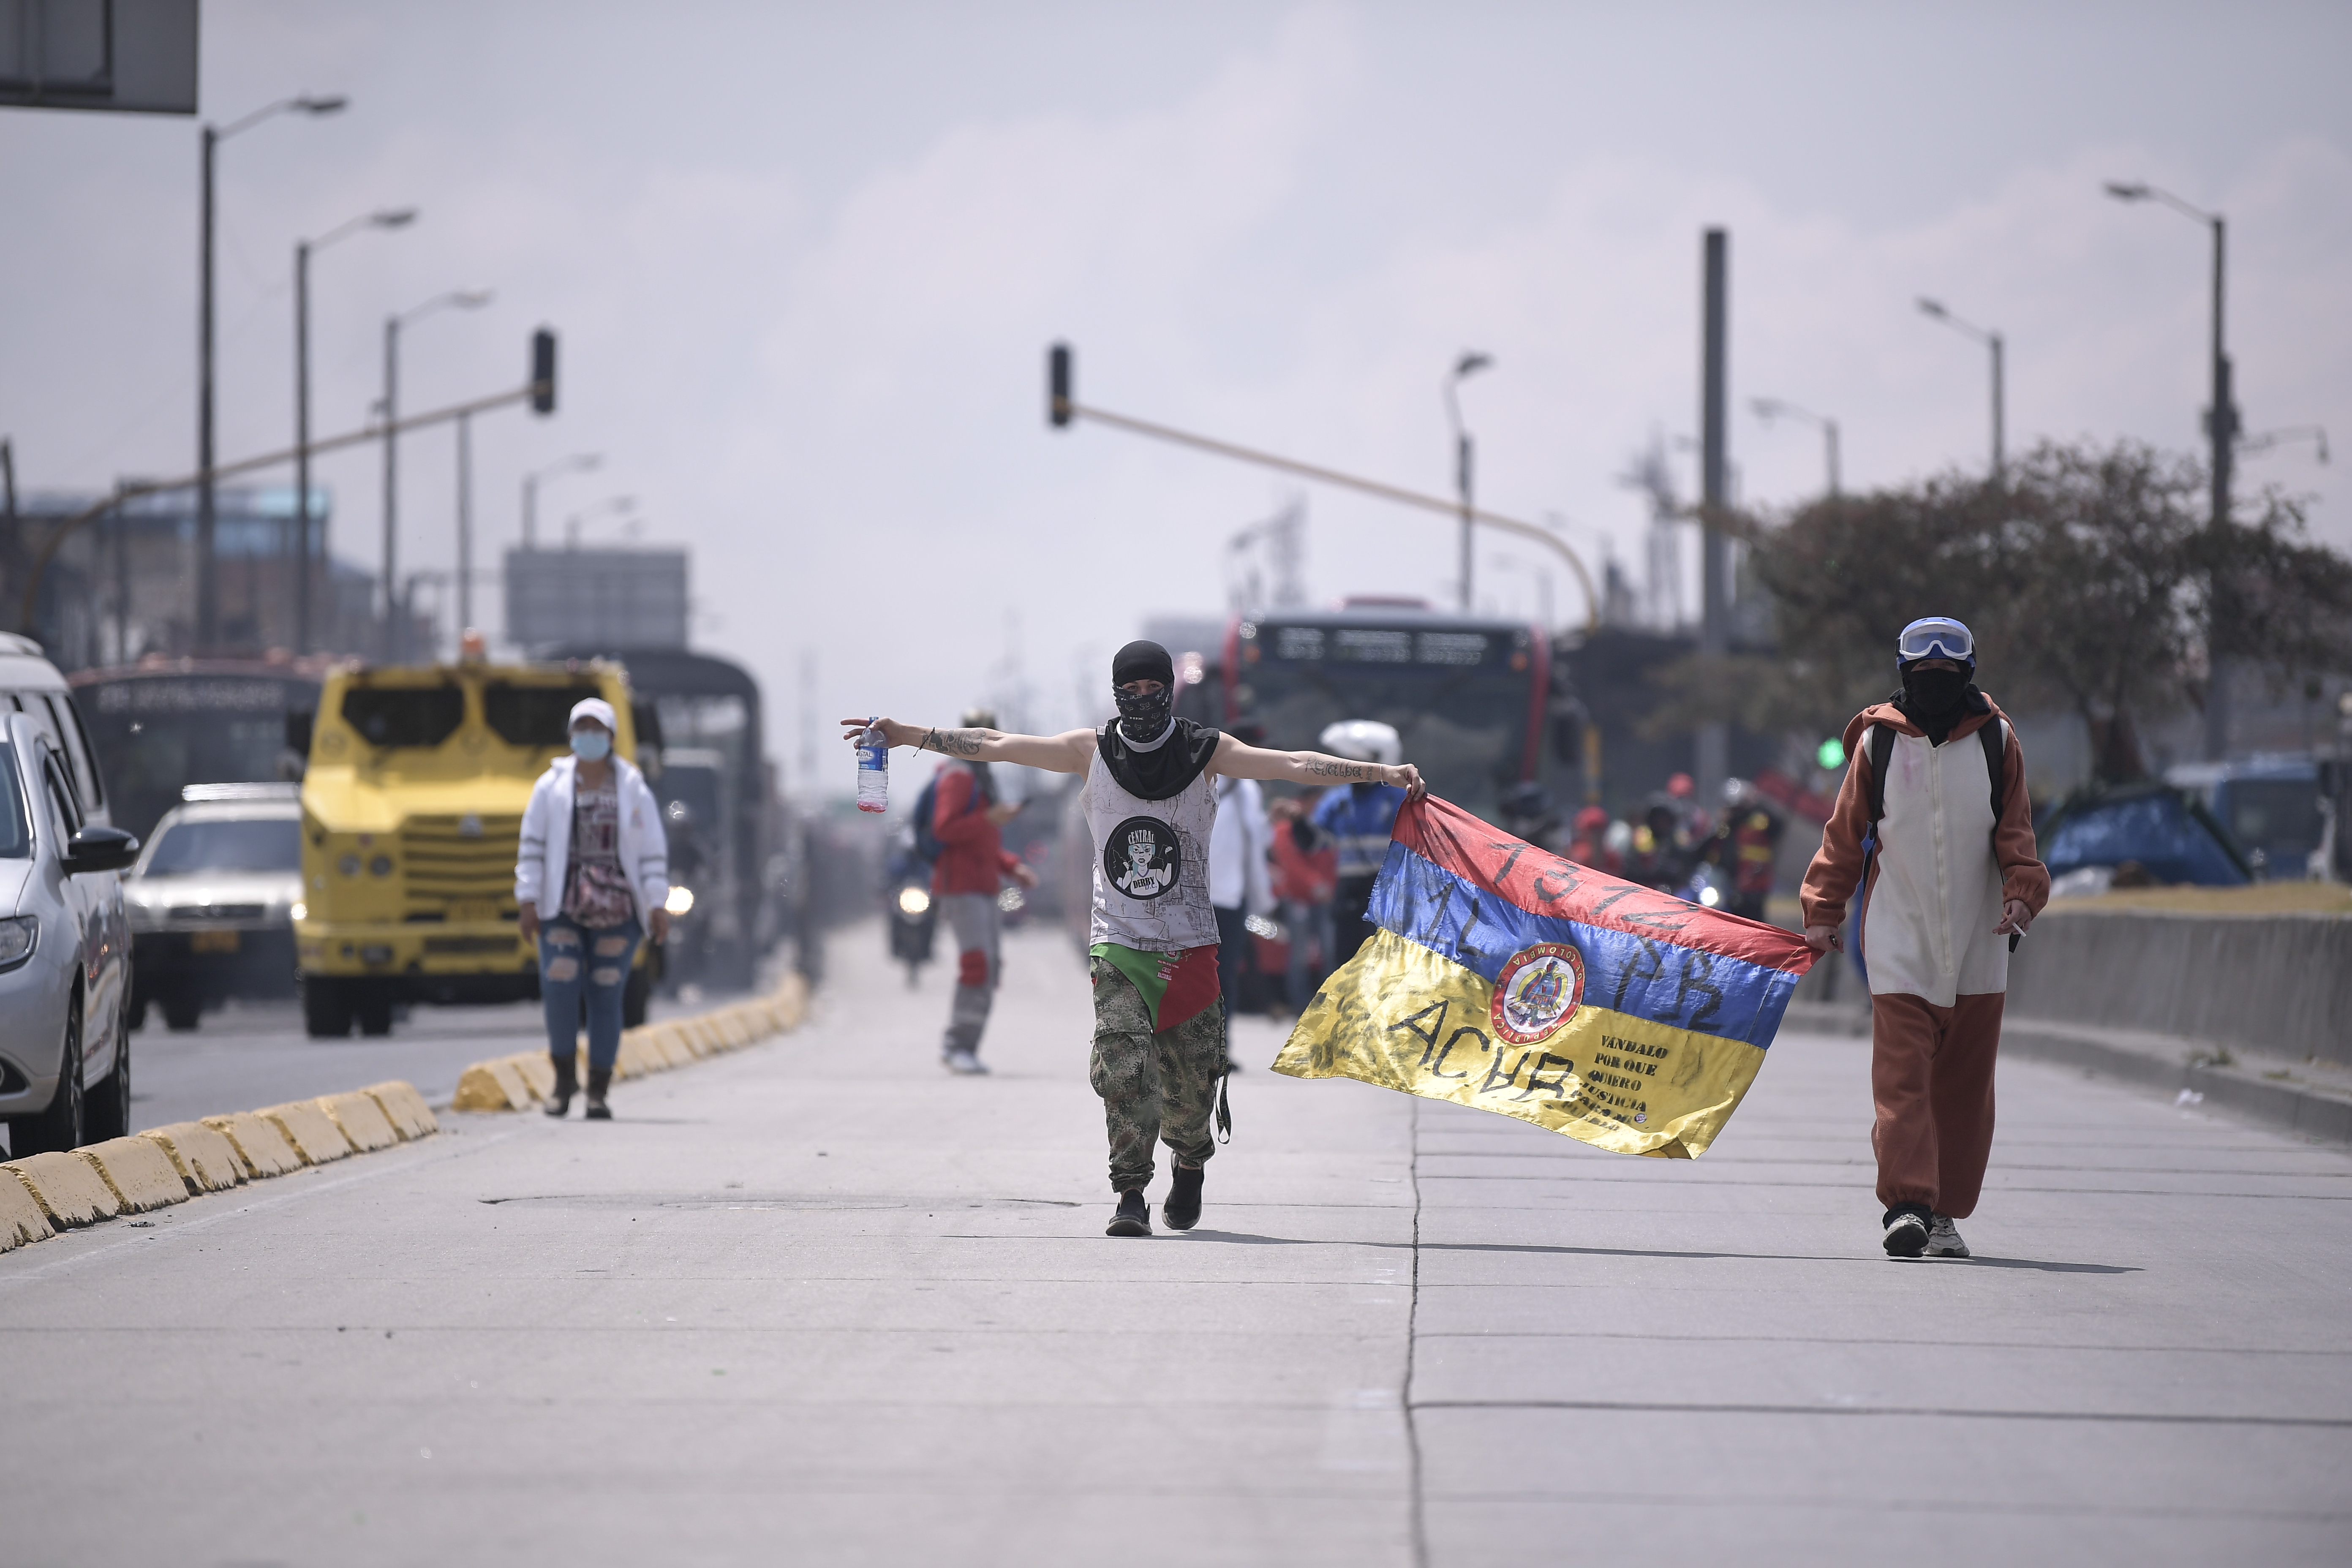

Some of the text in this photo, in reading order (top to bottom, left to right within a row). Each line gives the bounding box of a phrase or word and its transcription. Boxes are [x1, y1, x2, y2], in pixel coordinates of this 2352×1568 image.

[1128, 829, 1155, 845] CENTRAL
[1132, 876, 1154, 889] DERBY
[1488, 842, 1699, 930] 1312
[1512, 946, 1577, 966] COLOMBIA
[1575, 964, 1583, 980] DE
[1594, 1052, 1658, 1077] POR QUE
[1588, 1070, 1642, 1091] QUIERO
[1579, 1082, 1647, 1112] JUSTICIA
